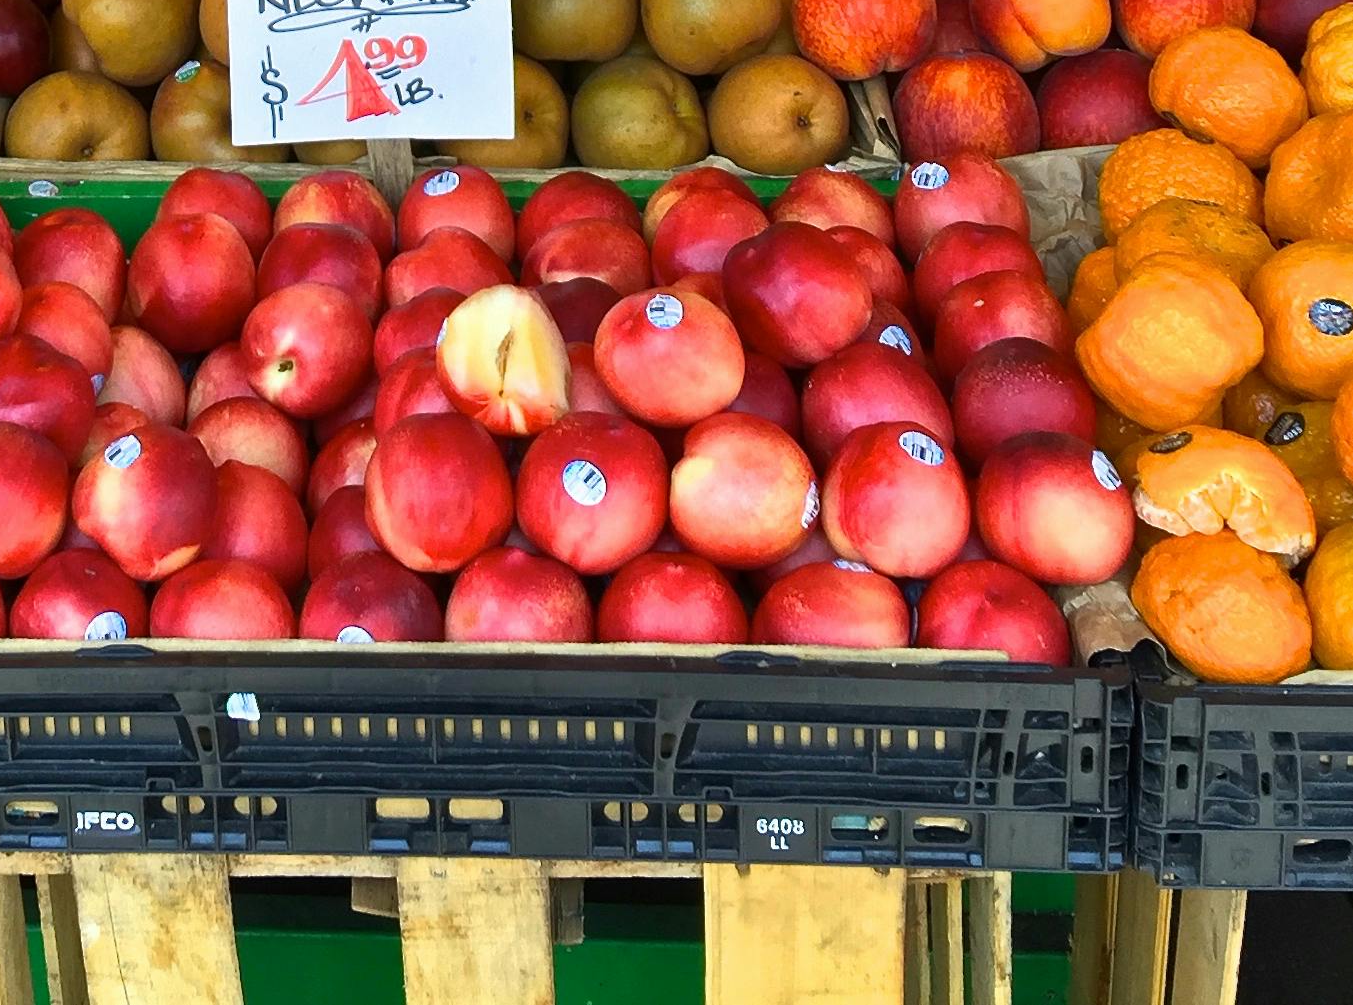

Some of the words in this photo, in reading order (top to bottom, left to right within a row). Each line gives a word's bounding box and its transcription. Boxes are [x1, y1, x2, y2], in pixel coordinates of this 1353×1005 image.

[395, 77, 444, 106] LB.
[76, 811, 135, 830] IFCO
[756, 818, 805, 834] 6408
[770, 836, 790, 850] LL
